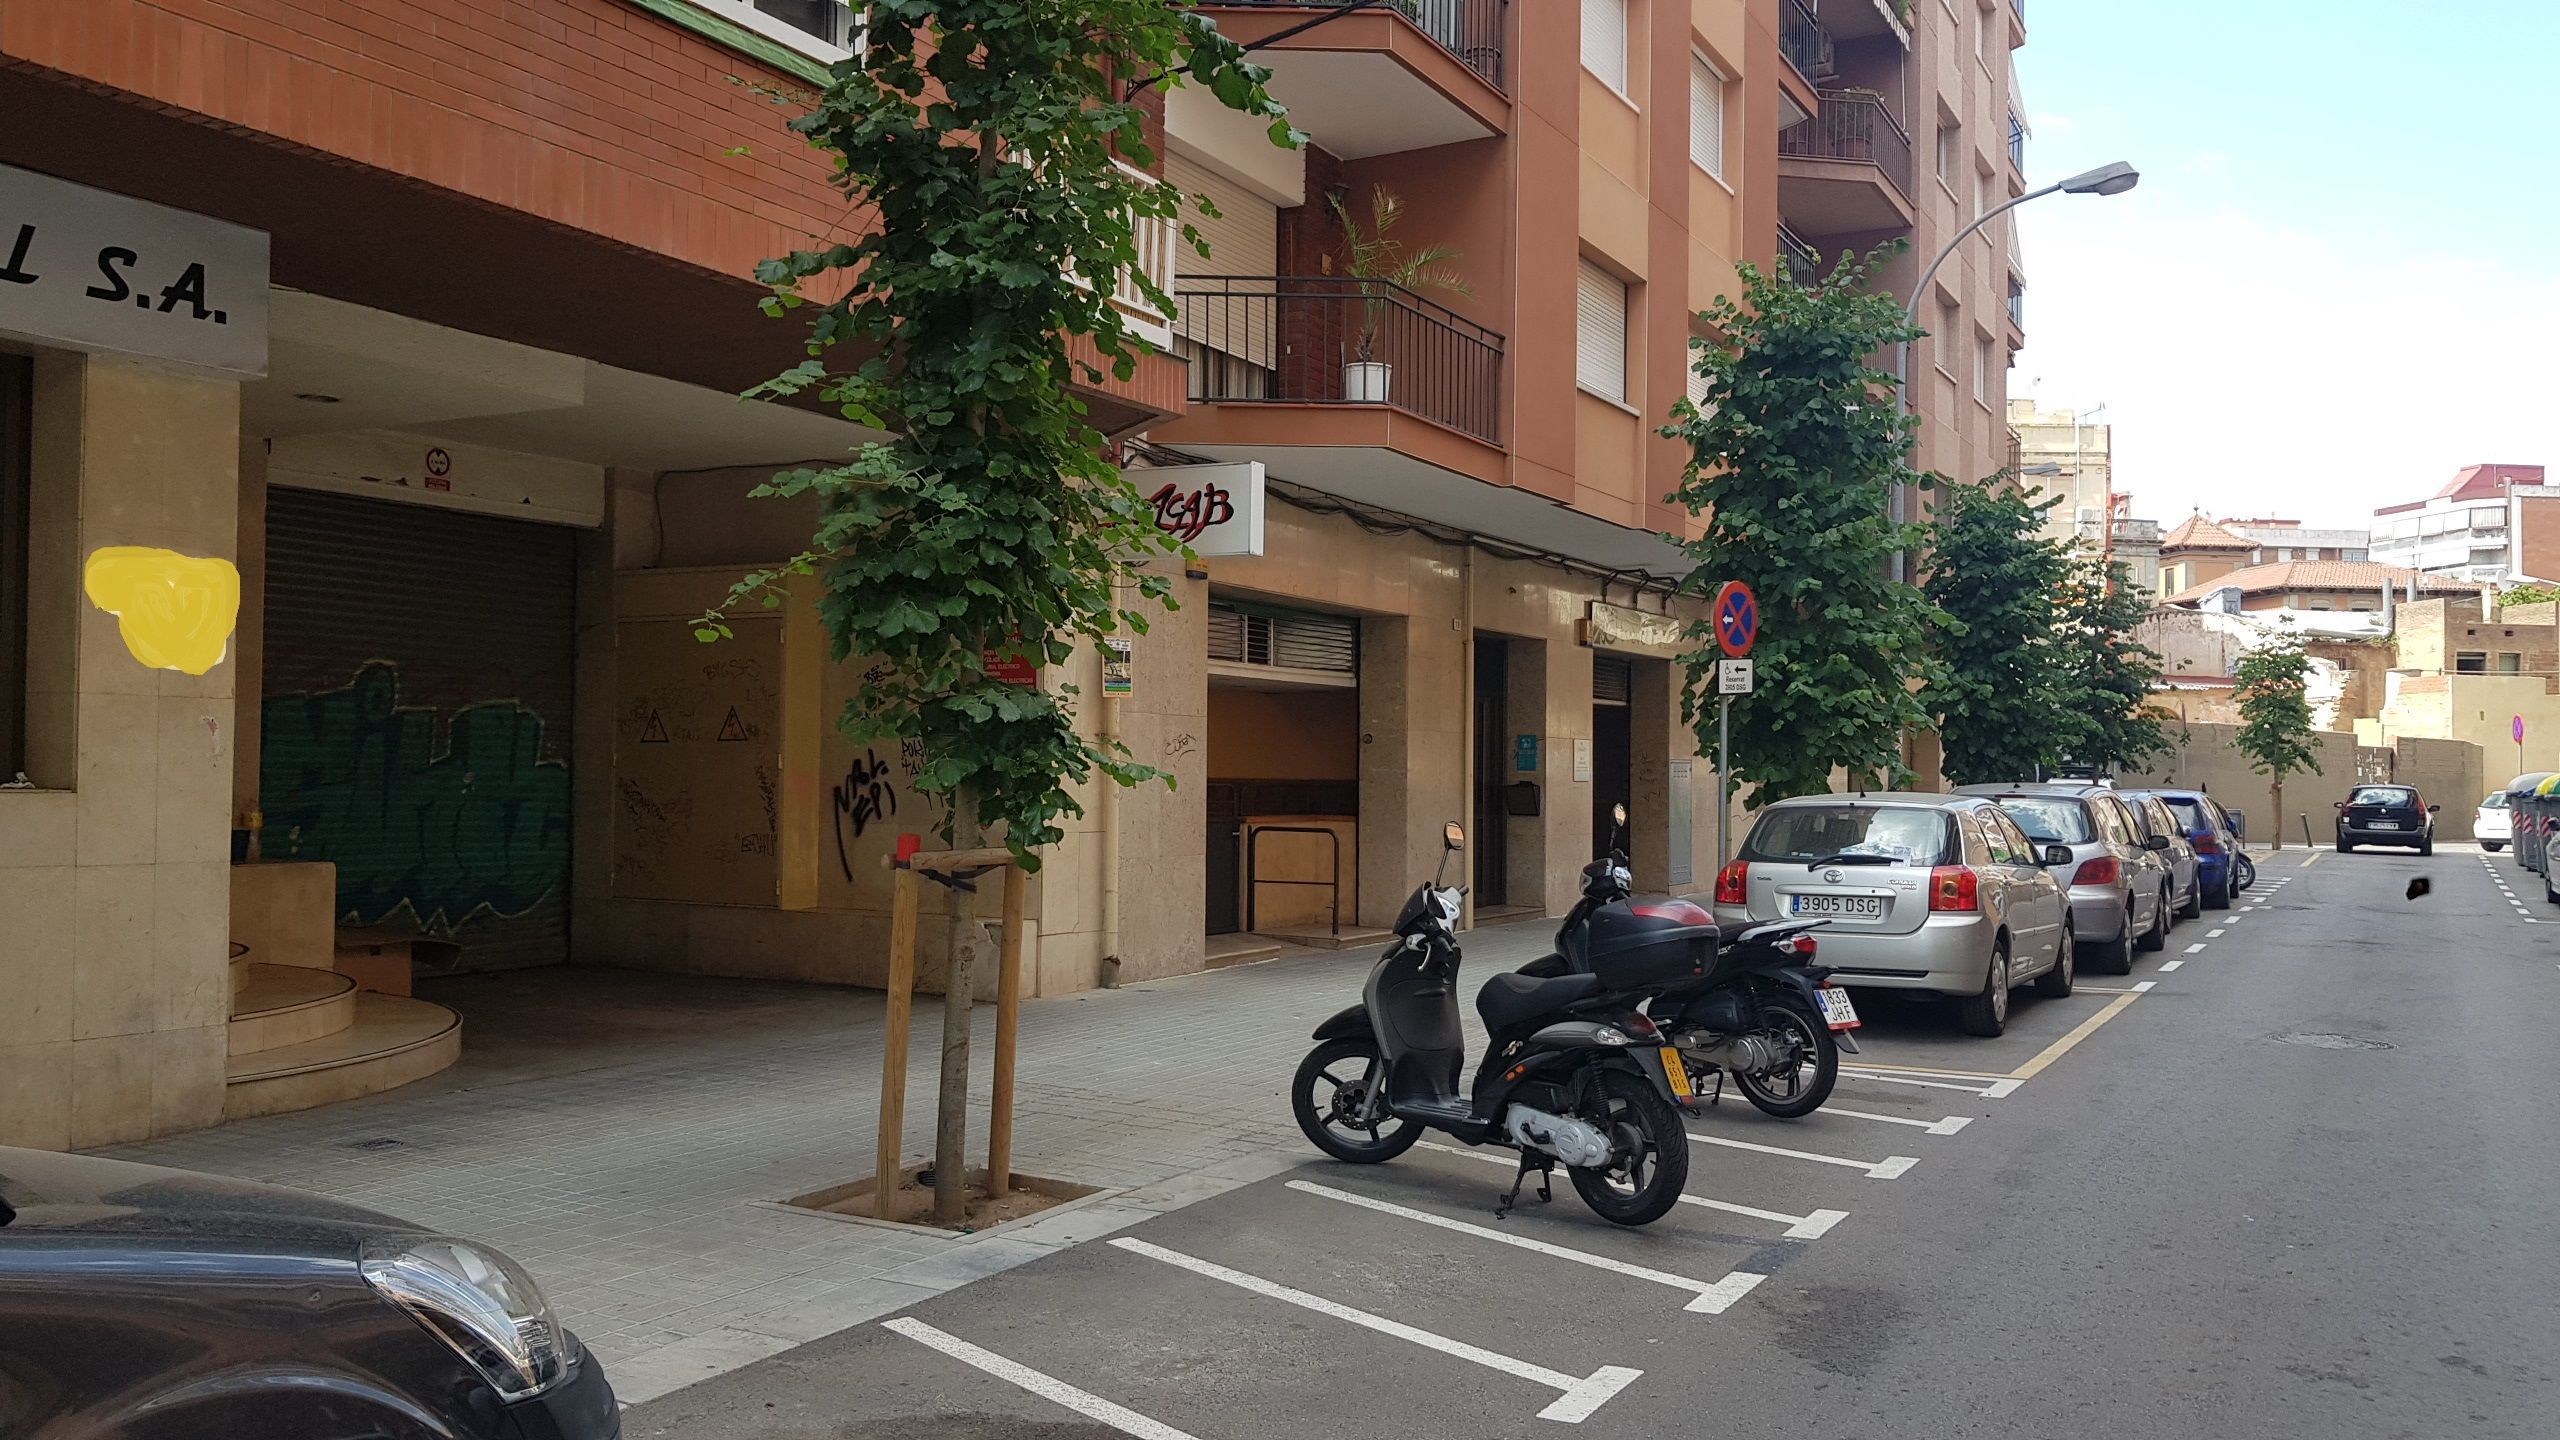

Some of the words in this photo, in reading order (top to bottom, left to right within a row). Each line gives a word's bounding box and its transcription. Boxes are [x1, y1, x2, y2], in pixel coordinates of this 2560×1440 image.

[86, 246, 227, 325] S.A.
[1802, 897, 1840, 911] 3905
[1845, 898, 1877, 913] DSG
